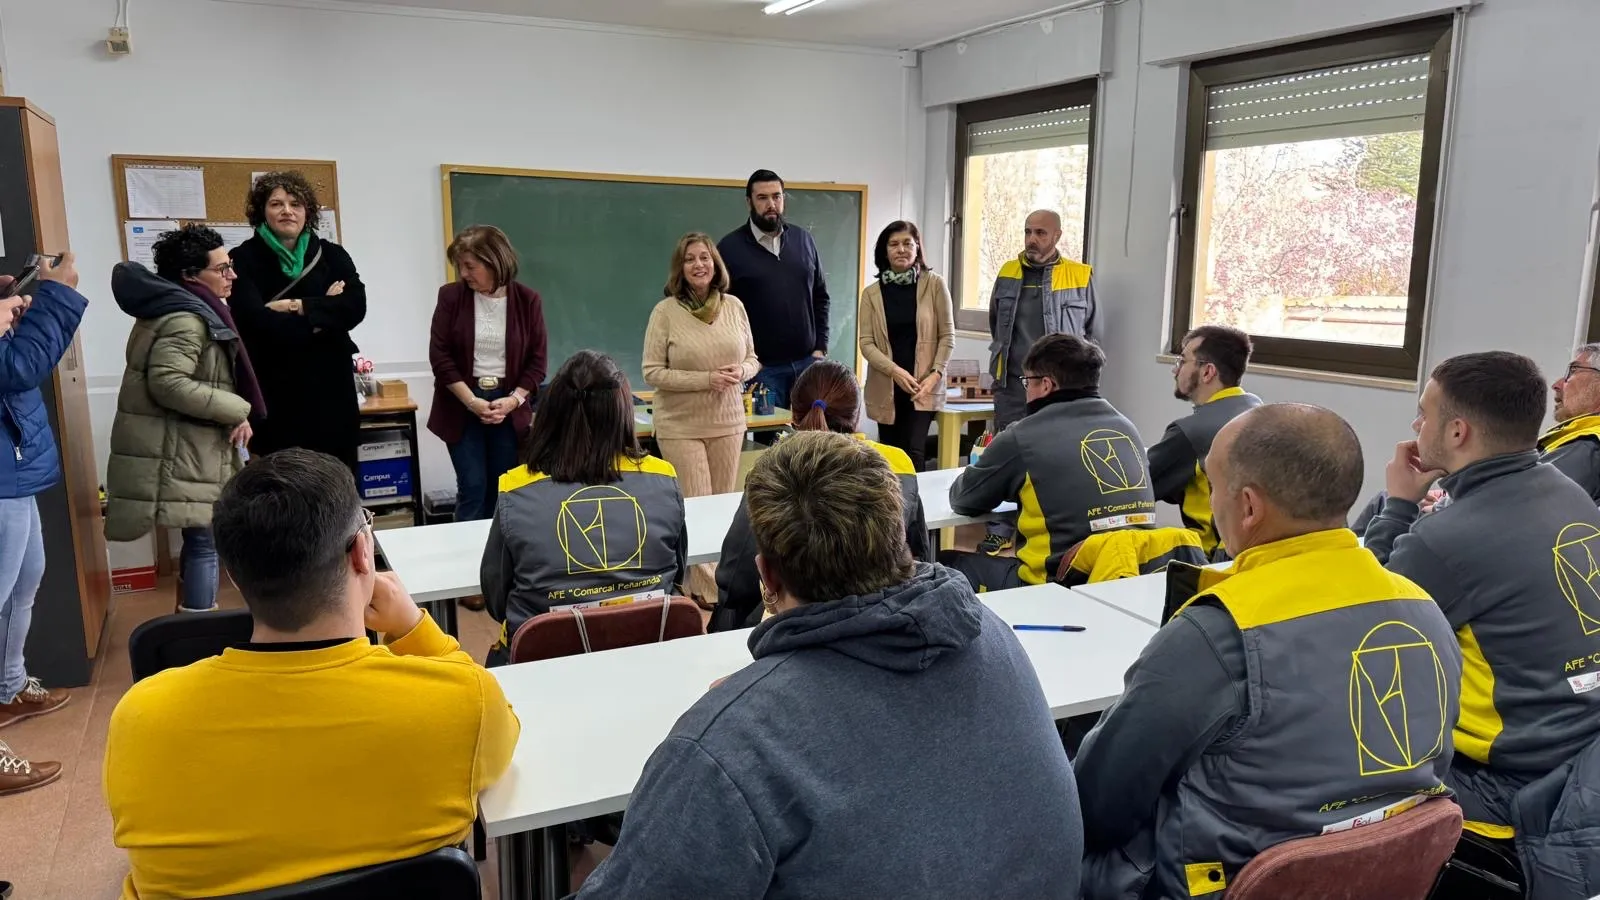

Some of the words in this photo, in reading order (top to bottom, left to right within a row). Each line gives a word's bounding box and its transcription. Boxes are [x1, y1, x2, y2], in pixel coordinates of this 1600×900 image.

[363, 473, 391, 482] Campus
[1087, 507, 1102, 517] AFE
[548, 590, 566, 600] AFE
[568, 584, 615, 597] "Comarcal
[1564, 657, 1586, 672] AFE
[1318, 800, 1348, 812] AFE
